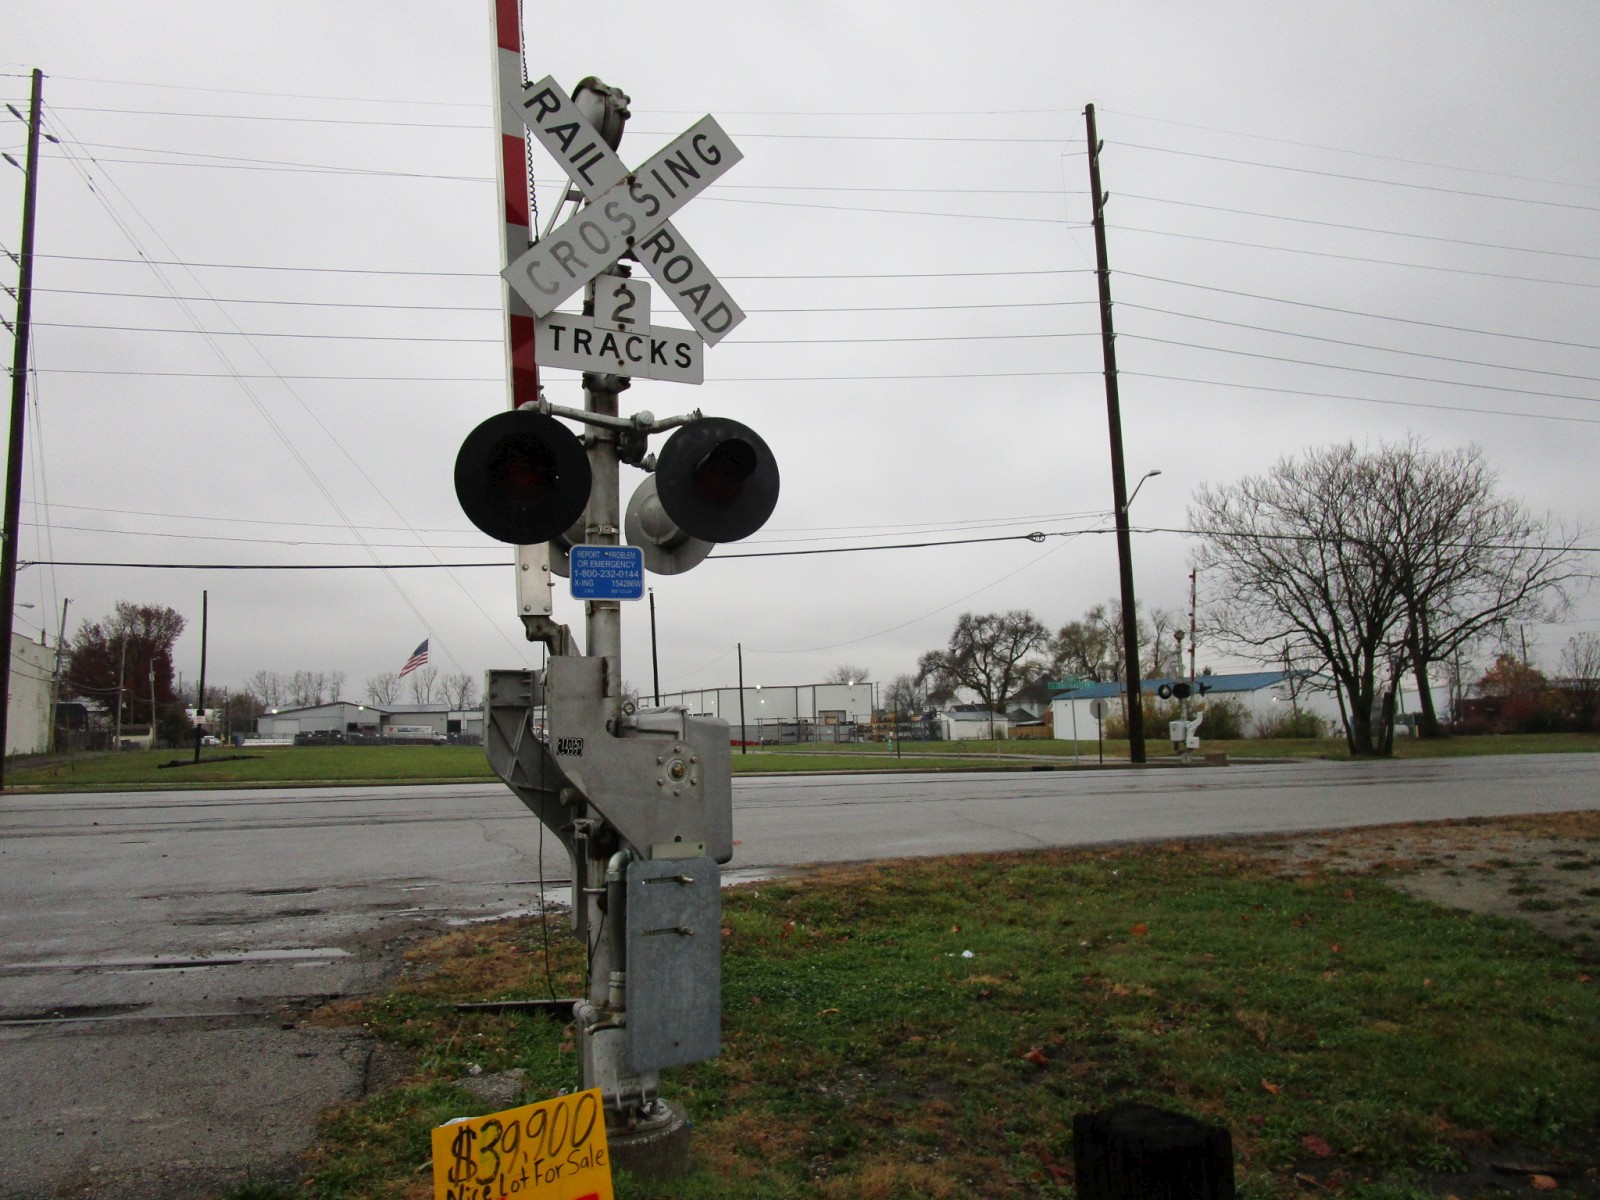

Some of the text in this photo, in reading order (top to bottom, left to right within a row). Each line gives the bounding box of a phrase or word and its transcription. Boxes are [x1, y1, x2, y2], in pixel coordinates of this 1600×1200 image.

[523, 87, 733, 333] RAIL ROAD
[525, 133, 722, 295] CROSSING
[610, 287, 636, 325] 2
[548, 324, 692, 369] TRACKS
[574, 570, 639, 578] 1-800-232-0144
[577, 551, 636, 559] REPORT PROBLEM
[590, 560, 636, 568] EMERGENCY
[500, 1166, 530, 1197] Lot
[534, 1158, 562, 1186] For
[567, 1144, 607, 1176] Sale
